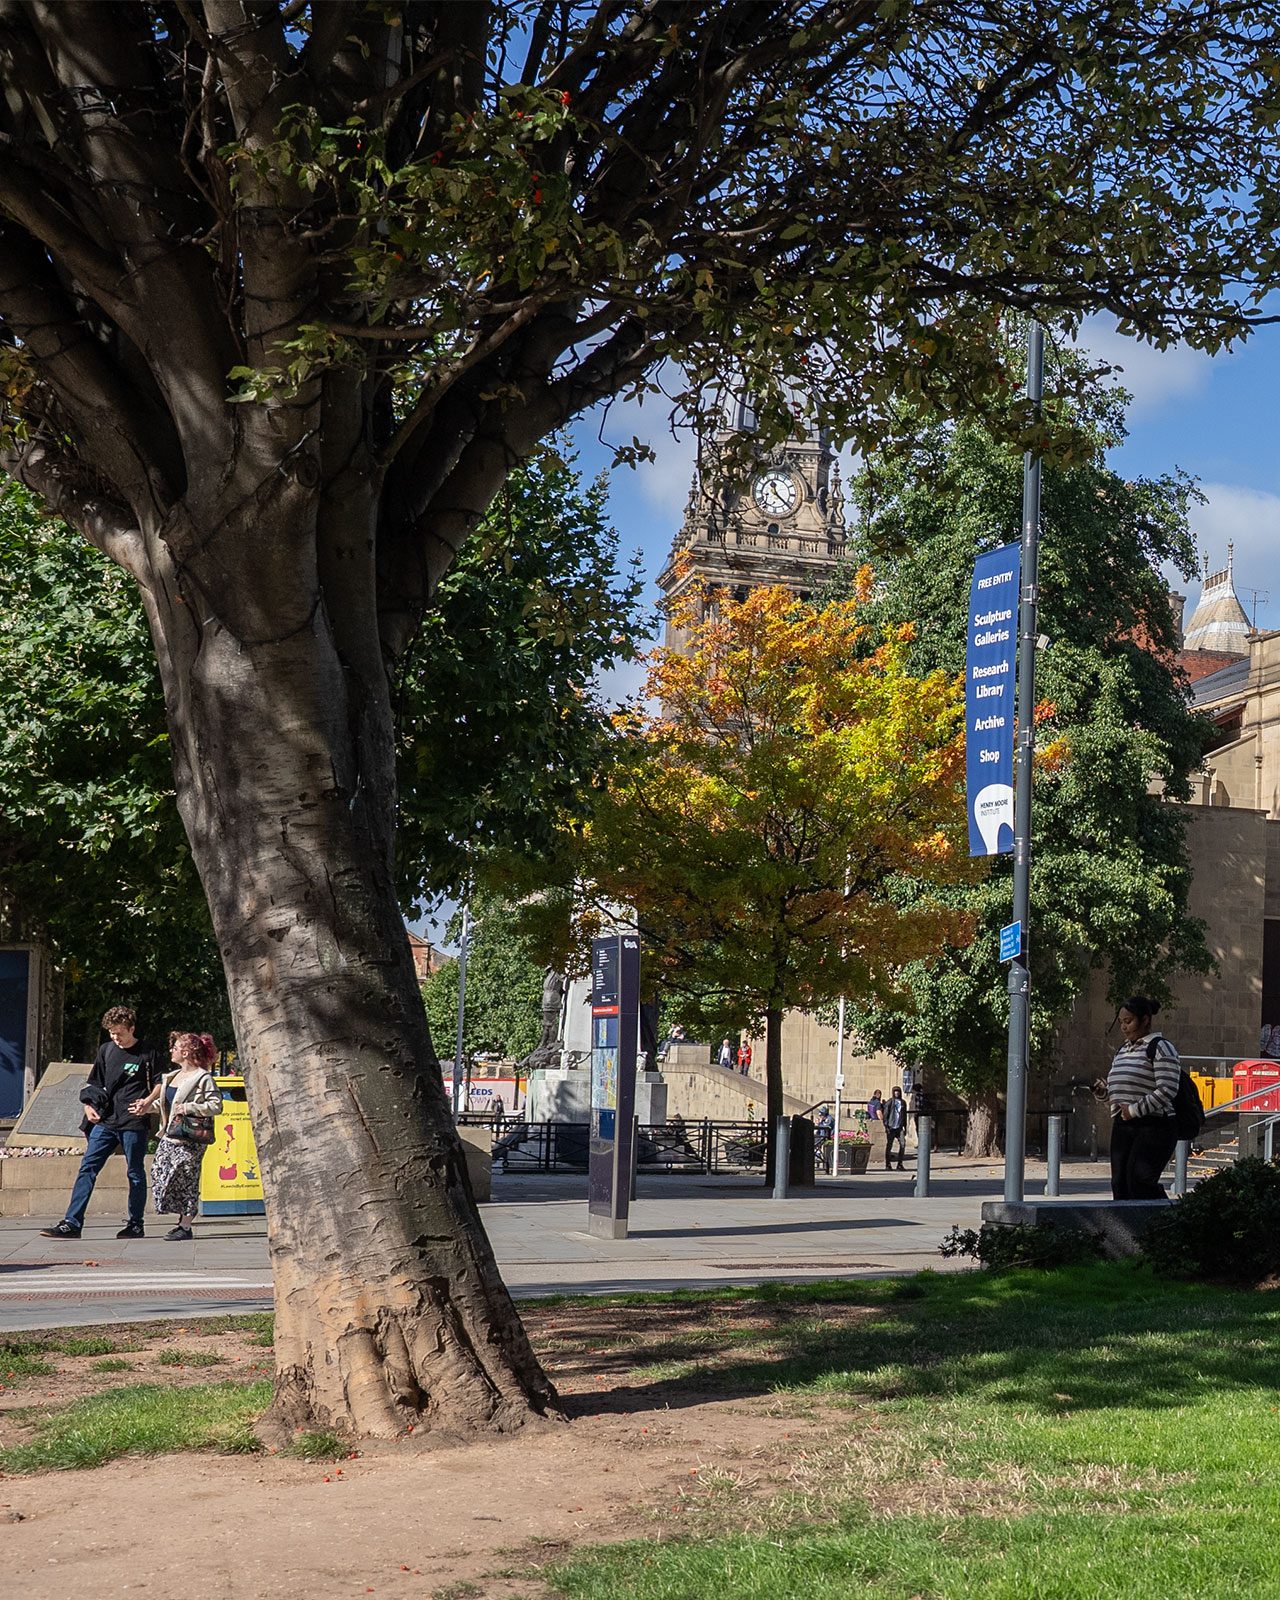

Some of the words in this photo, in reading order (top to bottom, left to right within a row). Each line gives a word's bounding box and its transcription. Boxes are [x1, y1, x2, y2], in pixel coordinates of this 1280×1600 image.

[978, 577, 994, 589] FREE
[993, 571, 1013, 585] ENTRY
[974, 610, 1011, 626] Sculpture
[975, 629, 1009, 646] Galleries
[973, 660, 1008, 679] Research
[977, 684, 1004, 698] Library
[975, 715, 1004, 731] Archive
[980, 749, 999, 763] Shop
[980, 801, 993, 810] HENRY
[994, 798, 1009, 808] MOORE
[471, 1088, 493, 1096] EEDS
